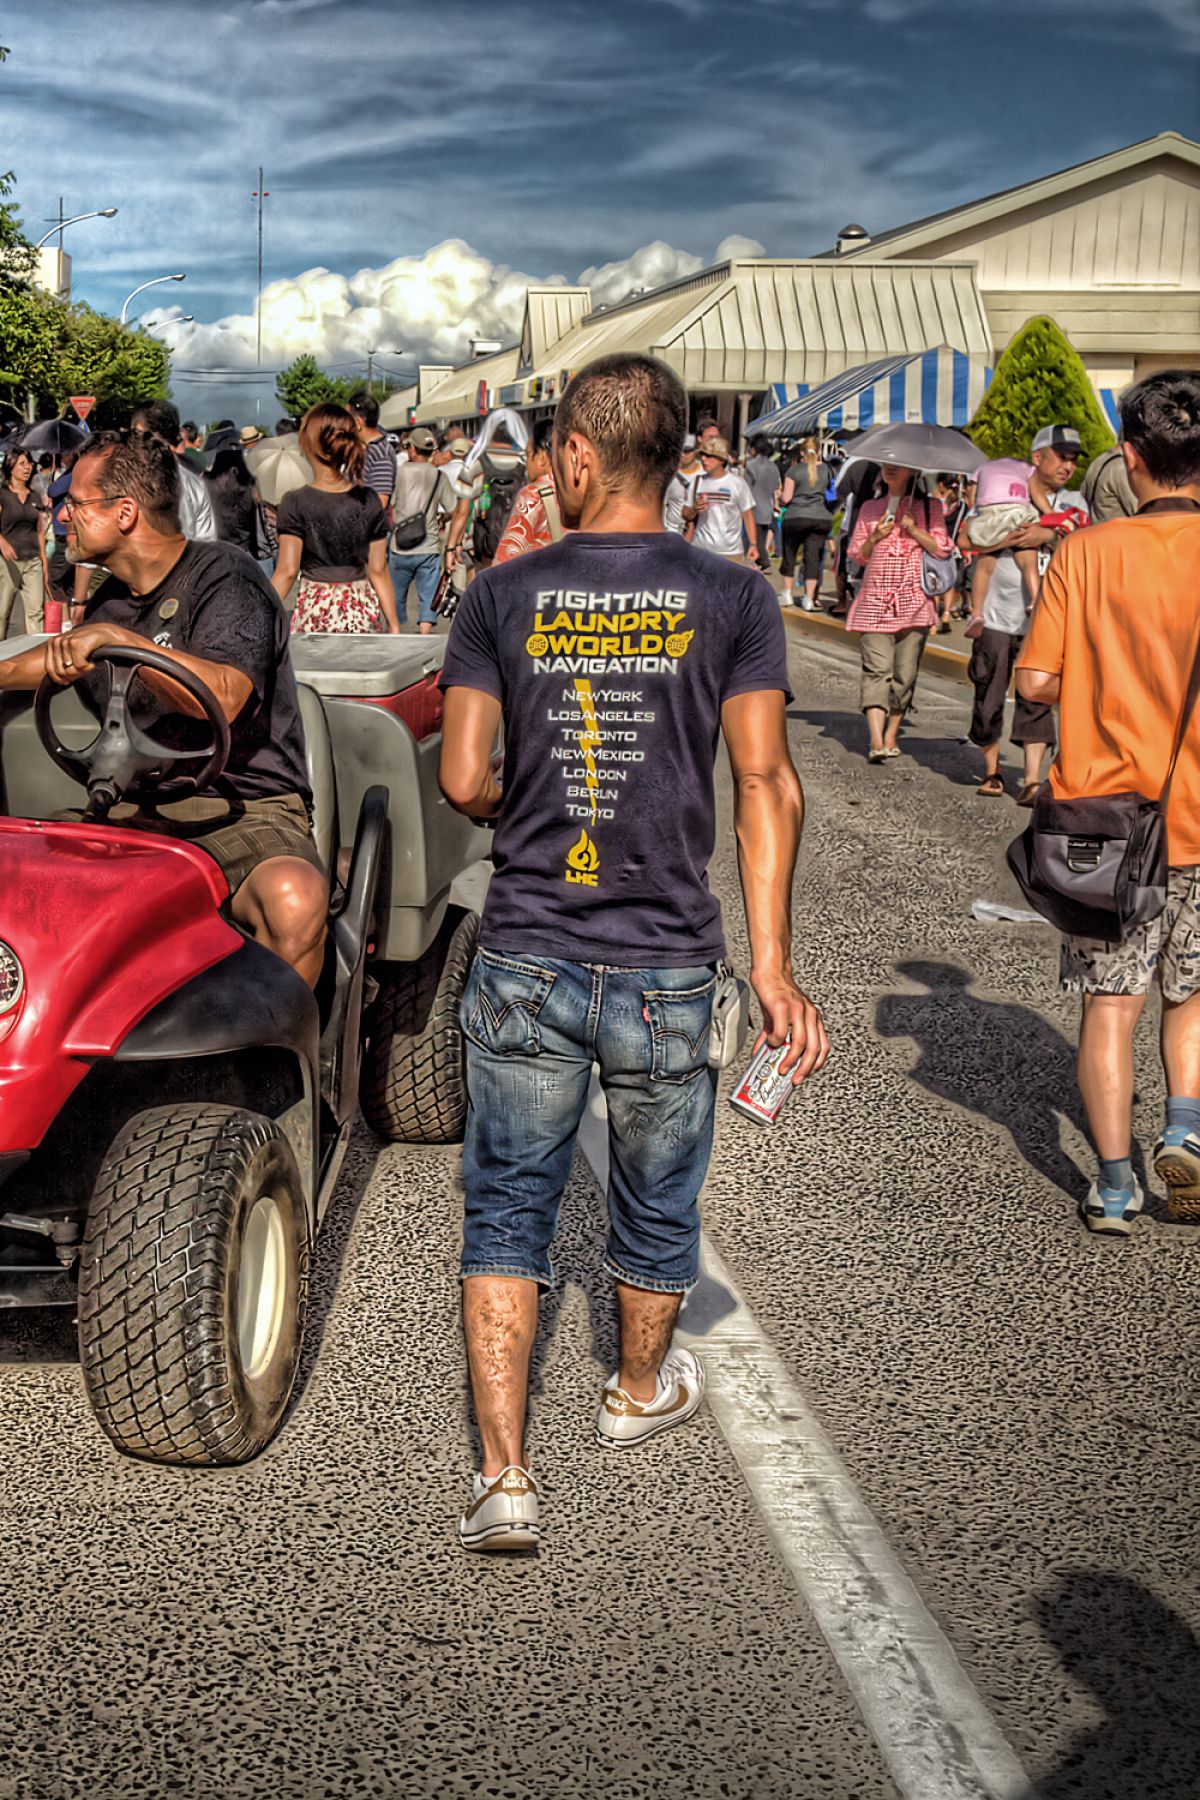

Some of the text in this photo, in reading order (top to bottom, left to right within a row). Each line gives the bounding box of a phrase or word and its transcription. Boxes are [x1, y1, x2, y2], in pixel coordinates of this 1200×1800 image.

[535, 589, 689, 612] FIGHTING
[534, 611, 686, 633] LAUNDRY
[548, 635, 664, 657] WORLD
[533, 657, 679, 675] NAVIGATION
[561, 729, 638, 742] TORONTO
[562, 766, 627, 781] LONDON
[566, 786, 618, 800] BERLIN
[565, 804, 615, 819] TOKYO
[565, 870, 600, 887] LHC
[606, 1394, 629, 1411] NIKE
[501, 1476, 529, 1489] NIKE
